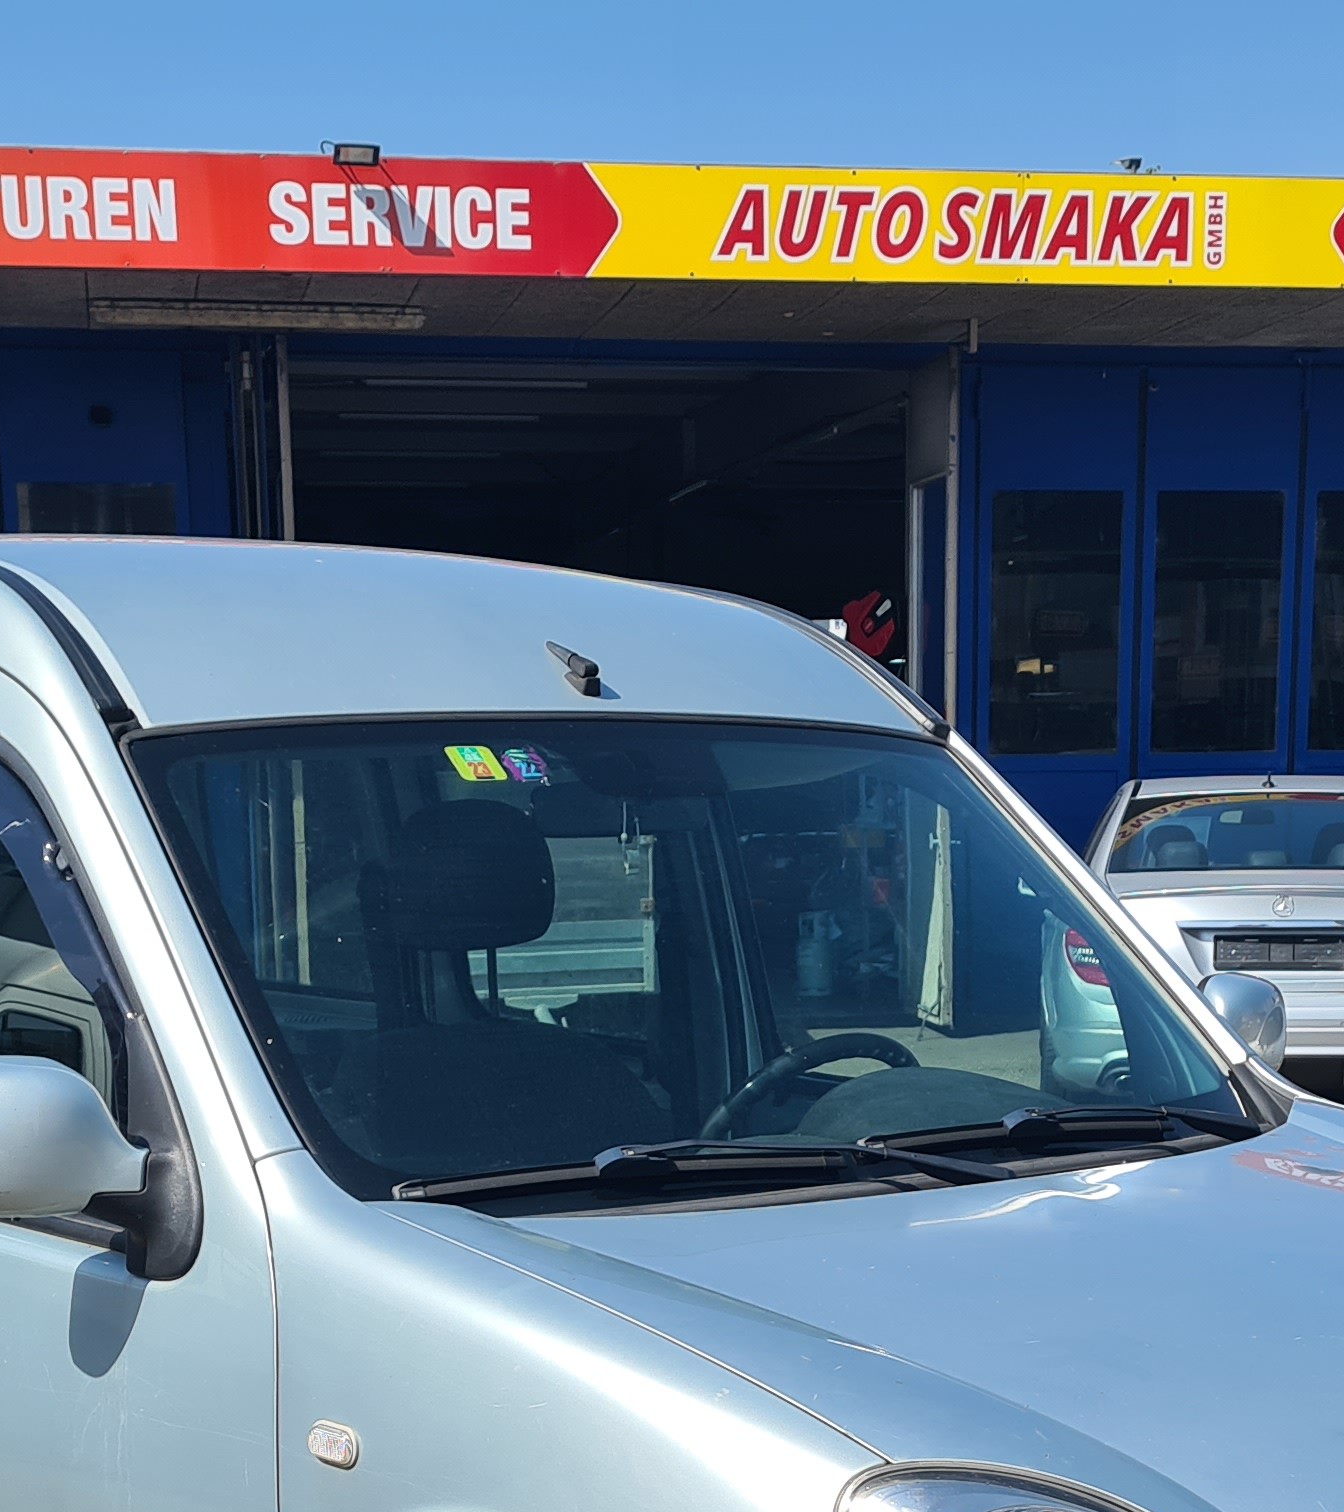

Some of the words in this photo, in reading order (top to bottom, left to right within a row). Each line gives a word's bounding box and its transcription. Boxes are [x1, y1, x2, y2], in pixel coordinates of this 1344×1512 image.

[267, 181, 533, 250] SERVICE
[714, 184, 928, 263] AUTO
[934, 189, 1193, 267] SMAKA
[1205, 194, 1225, 267] GMBH
